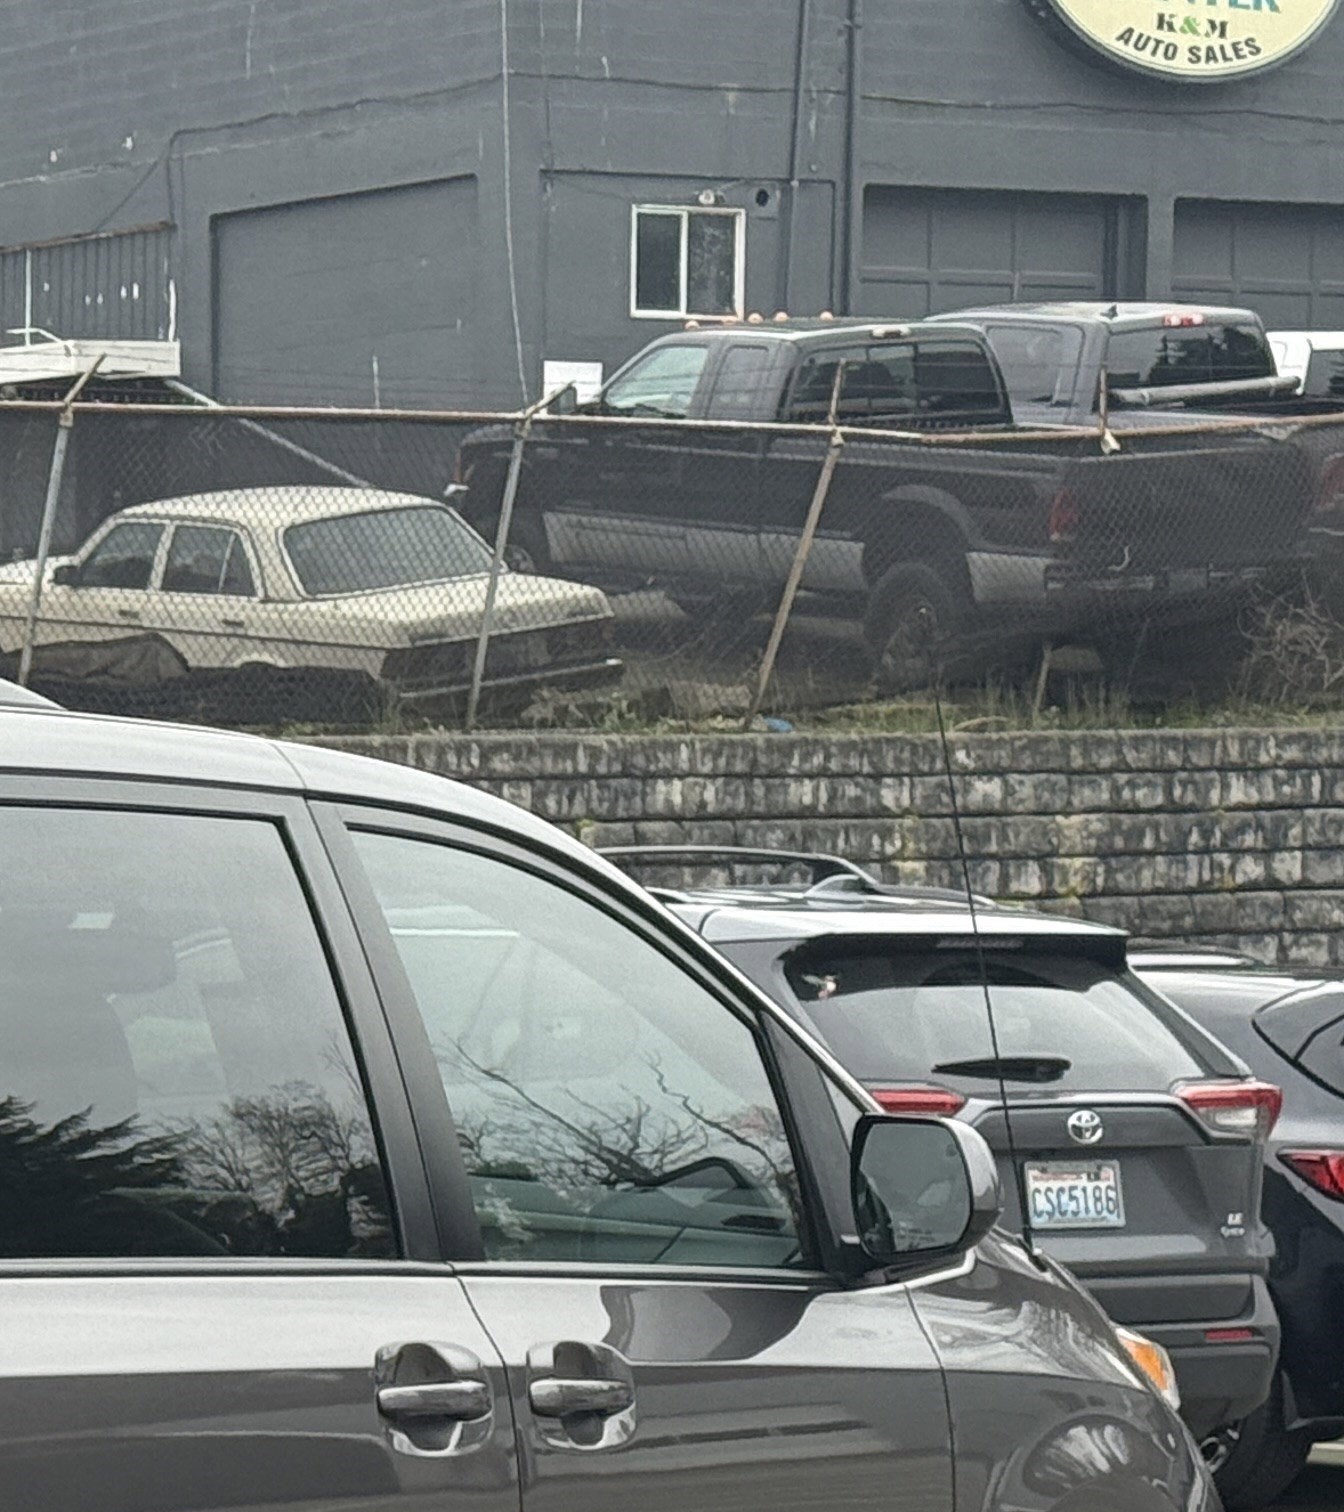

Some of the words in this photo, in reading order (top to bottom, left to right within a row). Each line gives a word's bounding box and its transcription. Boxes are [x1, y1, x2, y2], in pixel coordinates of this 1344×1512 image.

[1156, 12, 1229, 39] K&M
[1115, 26, 1179, 61] AUTO
[1187, 37, 1262, 64] SALES
[1033, 1184, 1117, 1218] CSC5186
